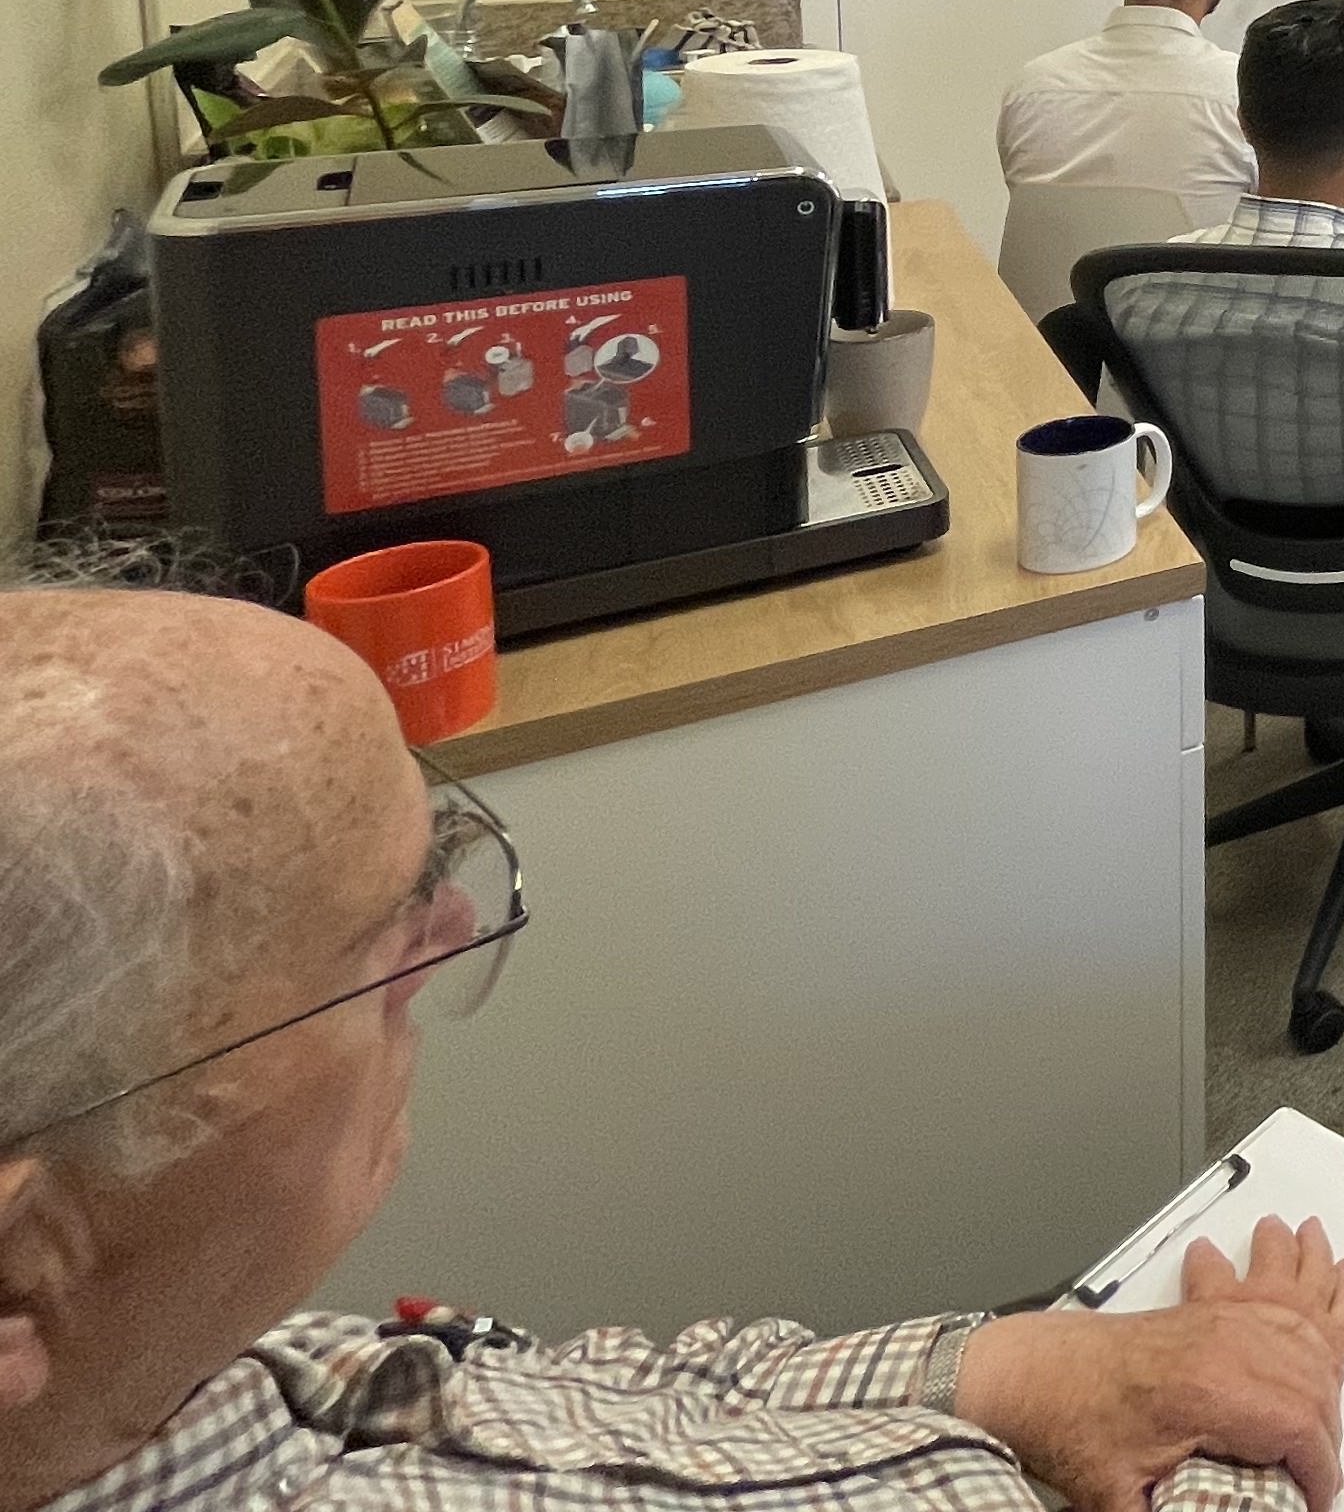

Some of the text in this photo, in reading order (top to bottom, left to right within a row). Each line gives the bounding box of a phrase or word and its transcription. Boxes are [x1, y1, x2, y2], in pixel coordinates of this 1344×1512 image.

[381, 290, 634, 331] READ THIS BEFORE USING
